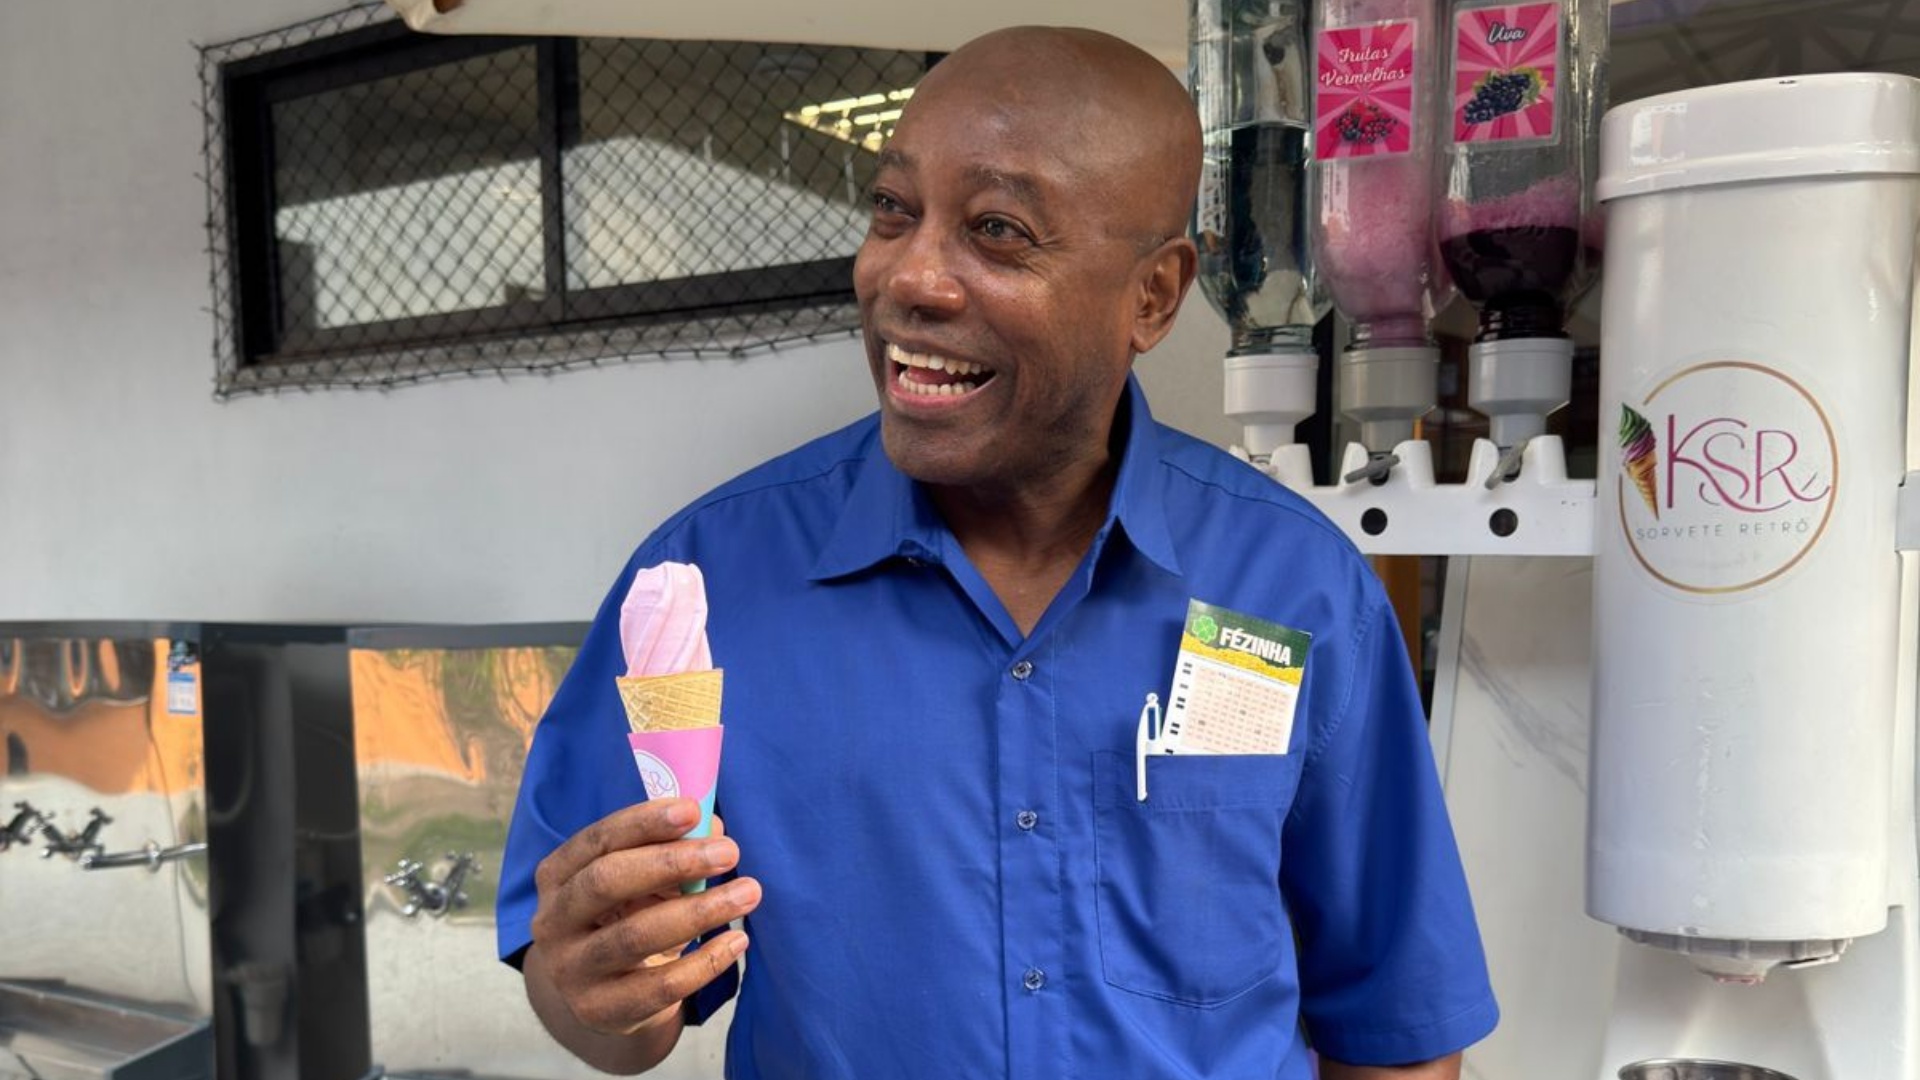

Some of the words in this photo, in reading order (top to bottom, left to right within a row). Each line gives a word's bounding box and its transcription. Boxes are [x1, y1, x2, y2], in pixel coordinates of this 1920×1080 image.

[1488, 22, 1526, 44] Uva
[1338, 47, 1389, 63] Frutas
[1320, 66, 1405, 86] Vermelhas
[1667, 414, 1830, 512] KSR
[1636, 524, 1724, 541] SORVETE
[1219, 627, 1292, 666] FÉZINHA
